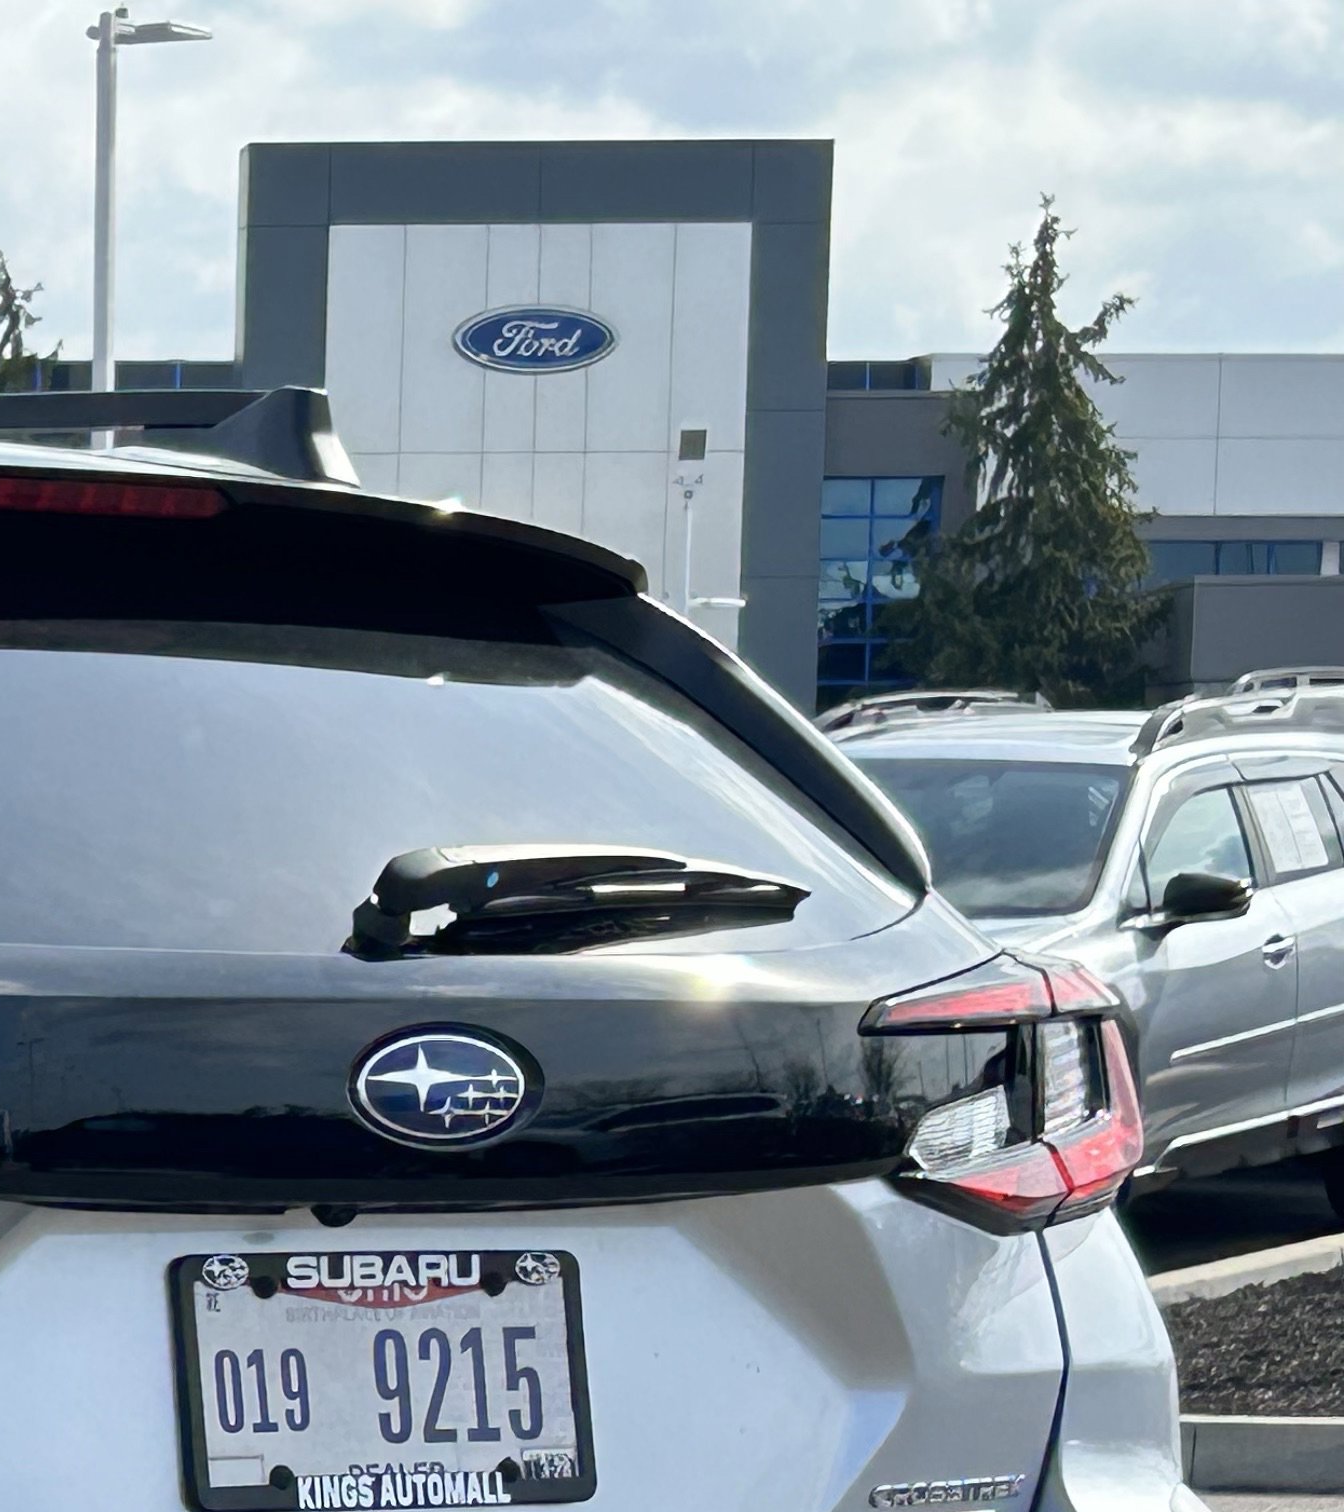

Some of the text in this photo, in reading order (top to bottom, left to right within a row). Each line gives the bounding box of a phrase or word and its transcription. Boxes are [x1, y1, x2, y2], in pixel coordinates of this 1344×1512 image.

[492, 319, 582, 357] Ford
[285, 1253, 482, 1289] SUBARU
[214, 1348, 311, 1434] 019
[372, 1325, 544, 1443] 9215
[297, 1471, 511, 1510] KINGS AUTOMALL
